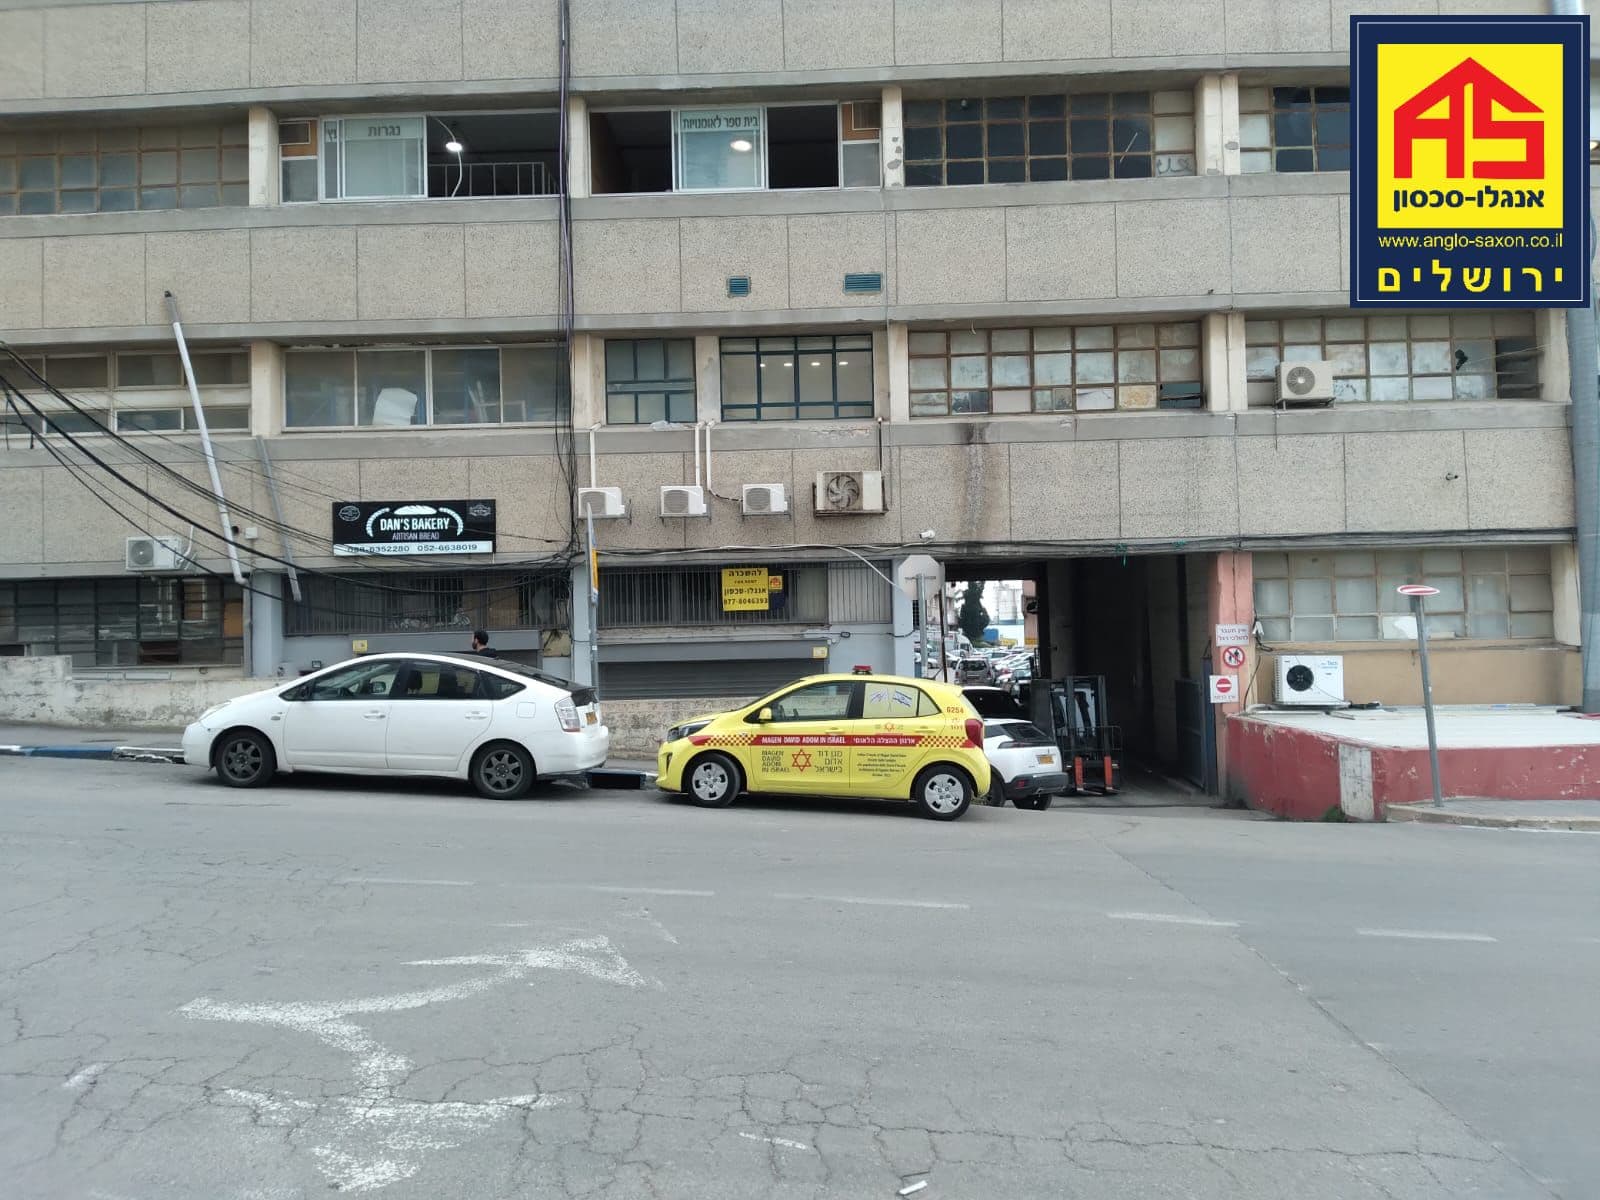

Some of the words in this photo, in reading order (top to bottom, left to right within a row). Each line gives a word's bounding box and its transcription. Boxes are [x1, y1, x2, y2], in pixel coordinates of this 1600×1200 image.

[683, 114, 722, 129] לאומנויות
[722, 116, 742, 128] ספר
[743, 115, 759, 127] בית
[367, 125, 401, 137] נגרות
[380, 518, 410, 532] DAN'S
[411, 517, 451, 531] BAKERY
[391, 532, 419, 541] ARTISAN
[418, 531, 440, 541] BREAD
[728, 569, 762, 577] להשכרה
[761, 736, 782, 744] MAGEN
[783, 736, 801, 744] DAVID
[802, 736, 819, 744] ADOM
[820, 736, 826, 744] IN
[827, 736, 846, 744] ISRAEL
[824, 758, 843, 766] אדום
